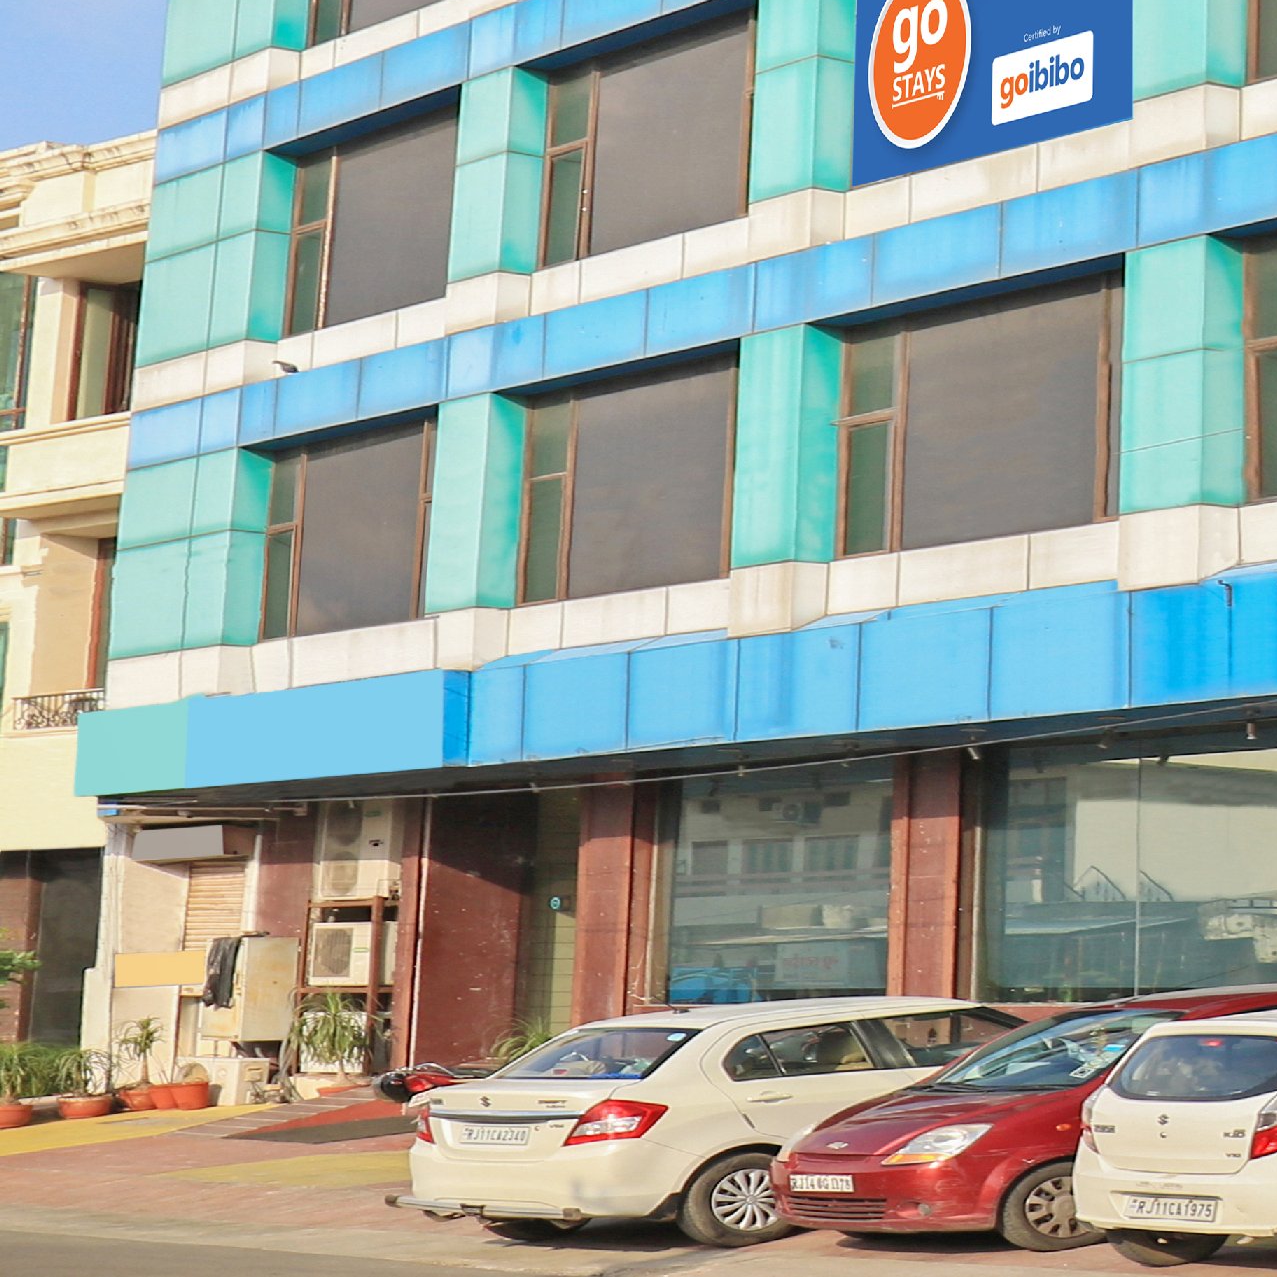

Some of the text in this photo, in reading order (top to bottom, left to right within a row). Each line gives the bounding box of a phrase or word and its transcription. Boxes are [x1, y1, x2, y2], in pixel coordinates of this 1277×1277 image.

[1023, 24, 1062, 42] Certified by
[892, 64, 946, 101] STAYS
[1000, 53, 1085, 109] goibibo
[1136, 1200, 1212, 1217] RJ11CA1975
